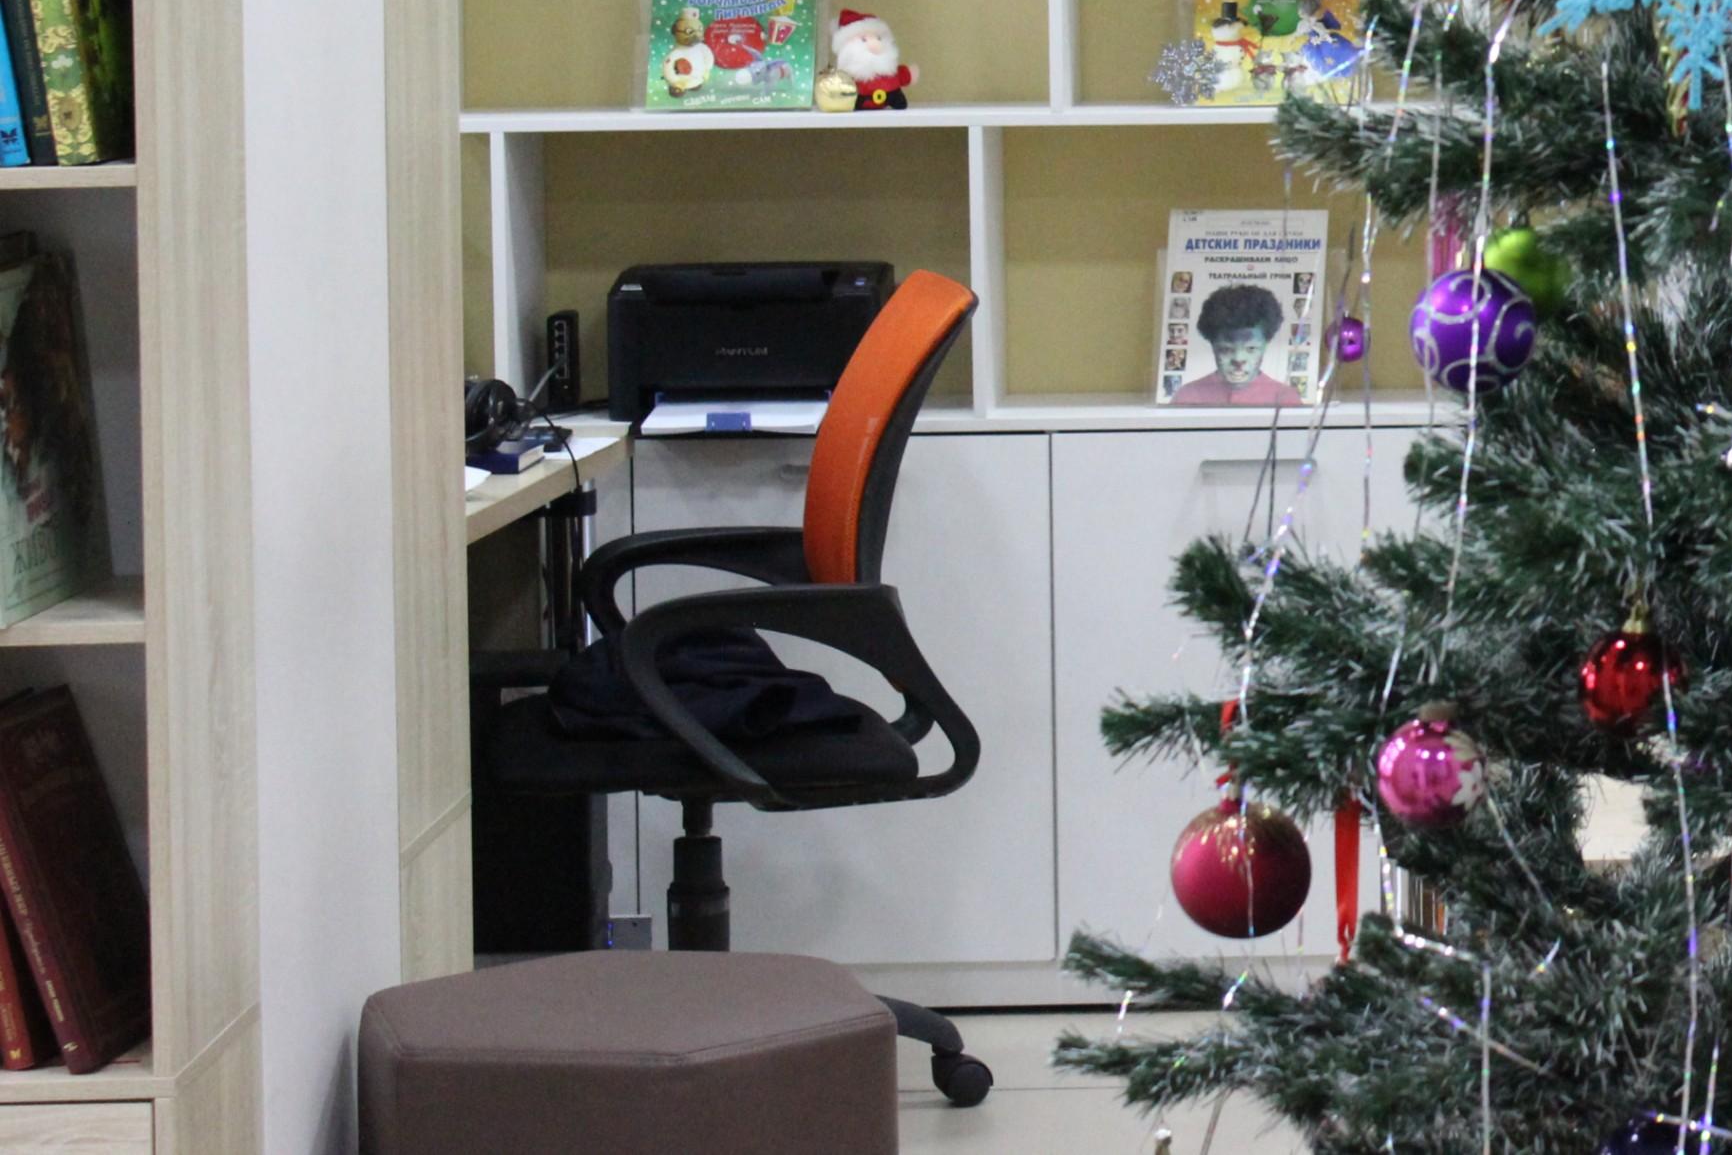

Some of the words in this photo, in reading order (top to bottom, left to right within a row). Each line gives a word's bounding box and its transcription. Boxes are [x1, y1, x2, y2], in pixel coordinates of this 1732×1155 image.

[1185, 239, 1239, 251] ДЕТСКИЕ
[1243, 239, 1321, 251] ПРАЗДНИКИ
[1204, 256, 1271, 264] РАСКРАШИВАЕМ
[1209, 272, 1267, 280] ТЕАТРАЛЬНЫЙ
[1269, 272, 1292, 280] ГРИМ
